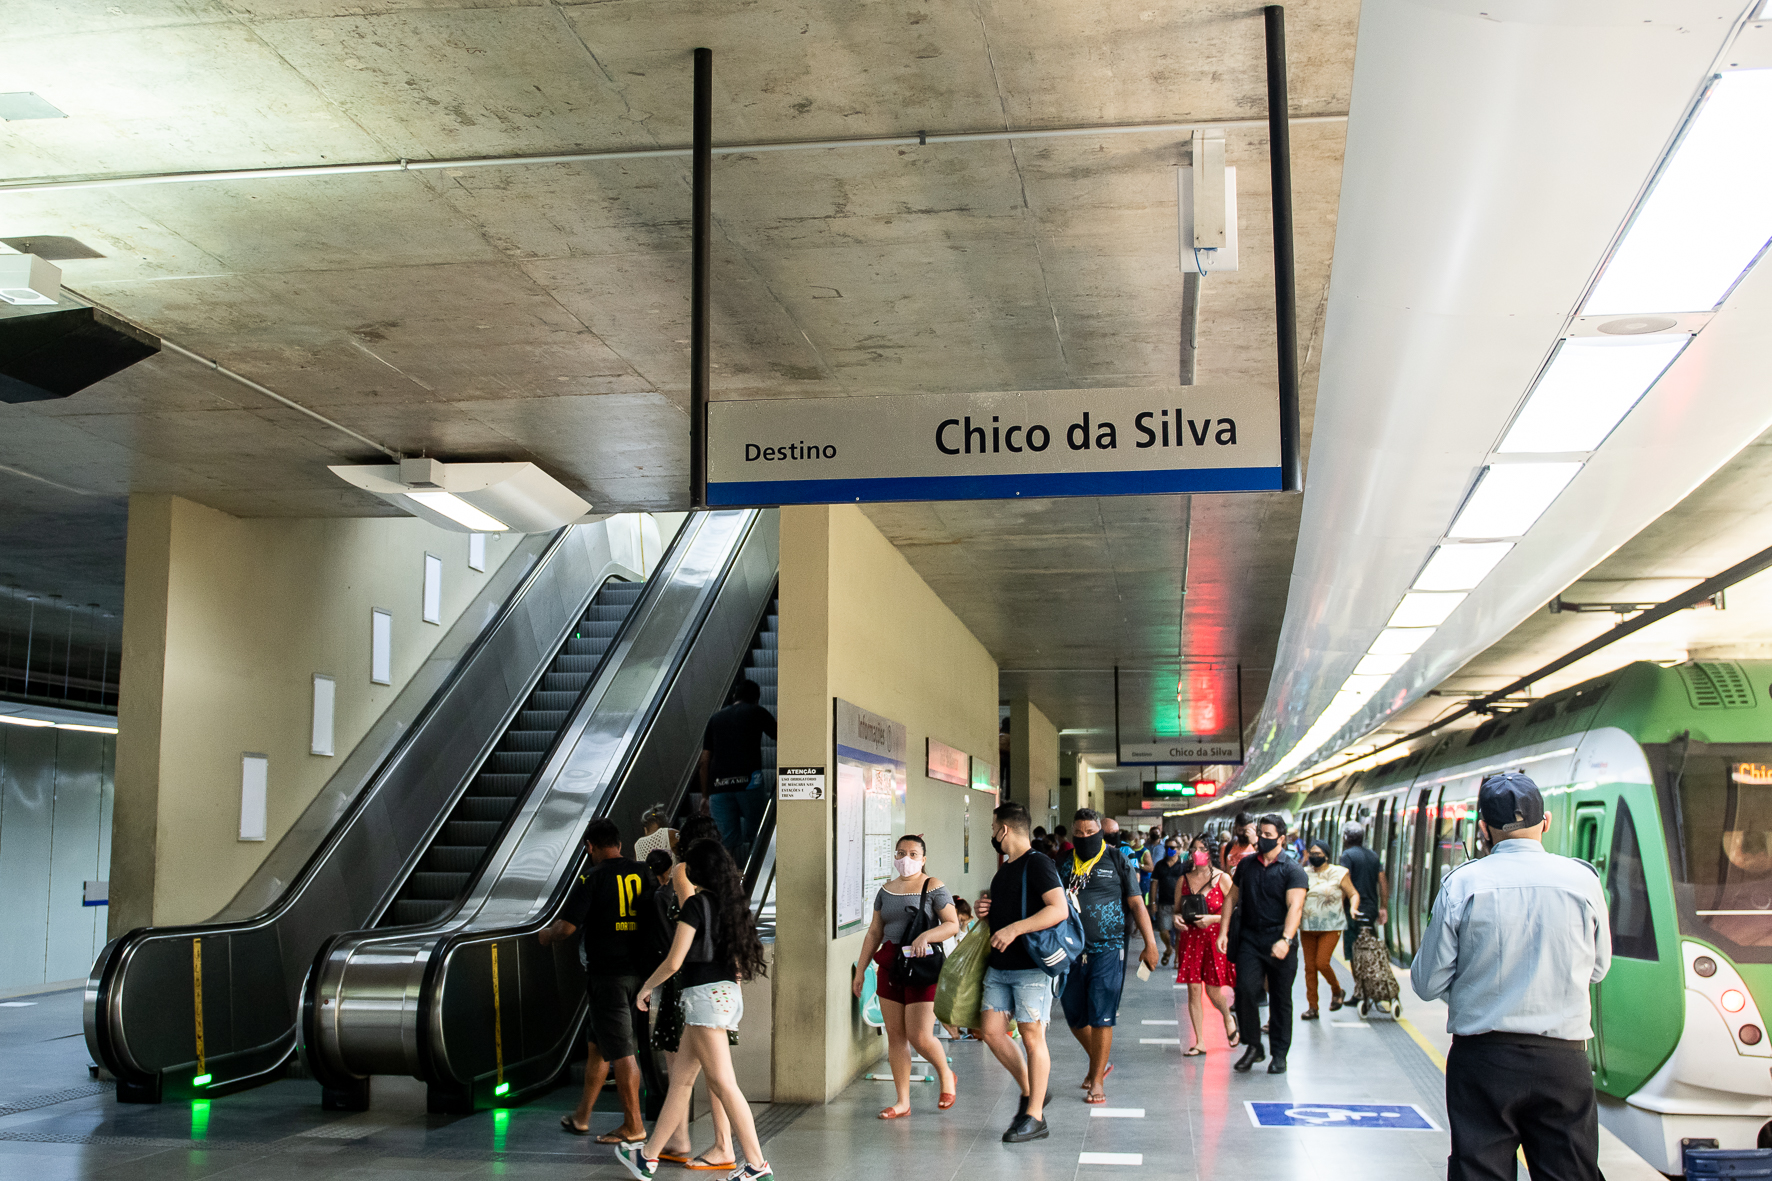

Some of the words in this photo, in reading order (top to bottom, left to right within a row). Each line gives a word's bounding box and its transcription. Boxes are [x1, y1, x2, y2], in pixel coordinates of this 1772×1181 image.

[936, 416, 1050, 455] Chico
[1067, 412, 1116, 450] da
[1135, 409, 1236, 448] Silva
[746, 441, 836, 461] Destino
[1169, 747, 1194, 757] Chico
[1196, 747, 1208, 757] da
[1210, 747, 1233, 757] Silva
[616, 873, 642, 917] 10
